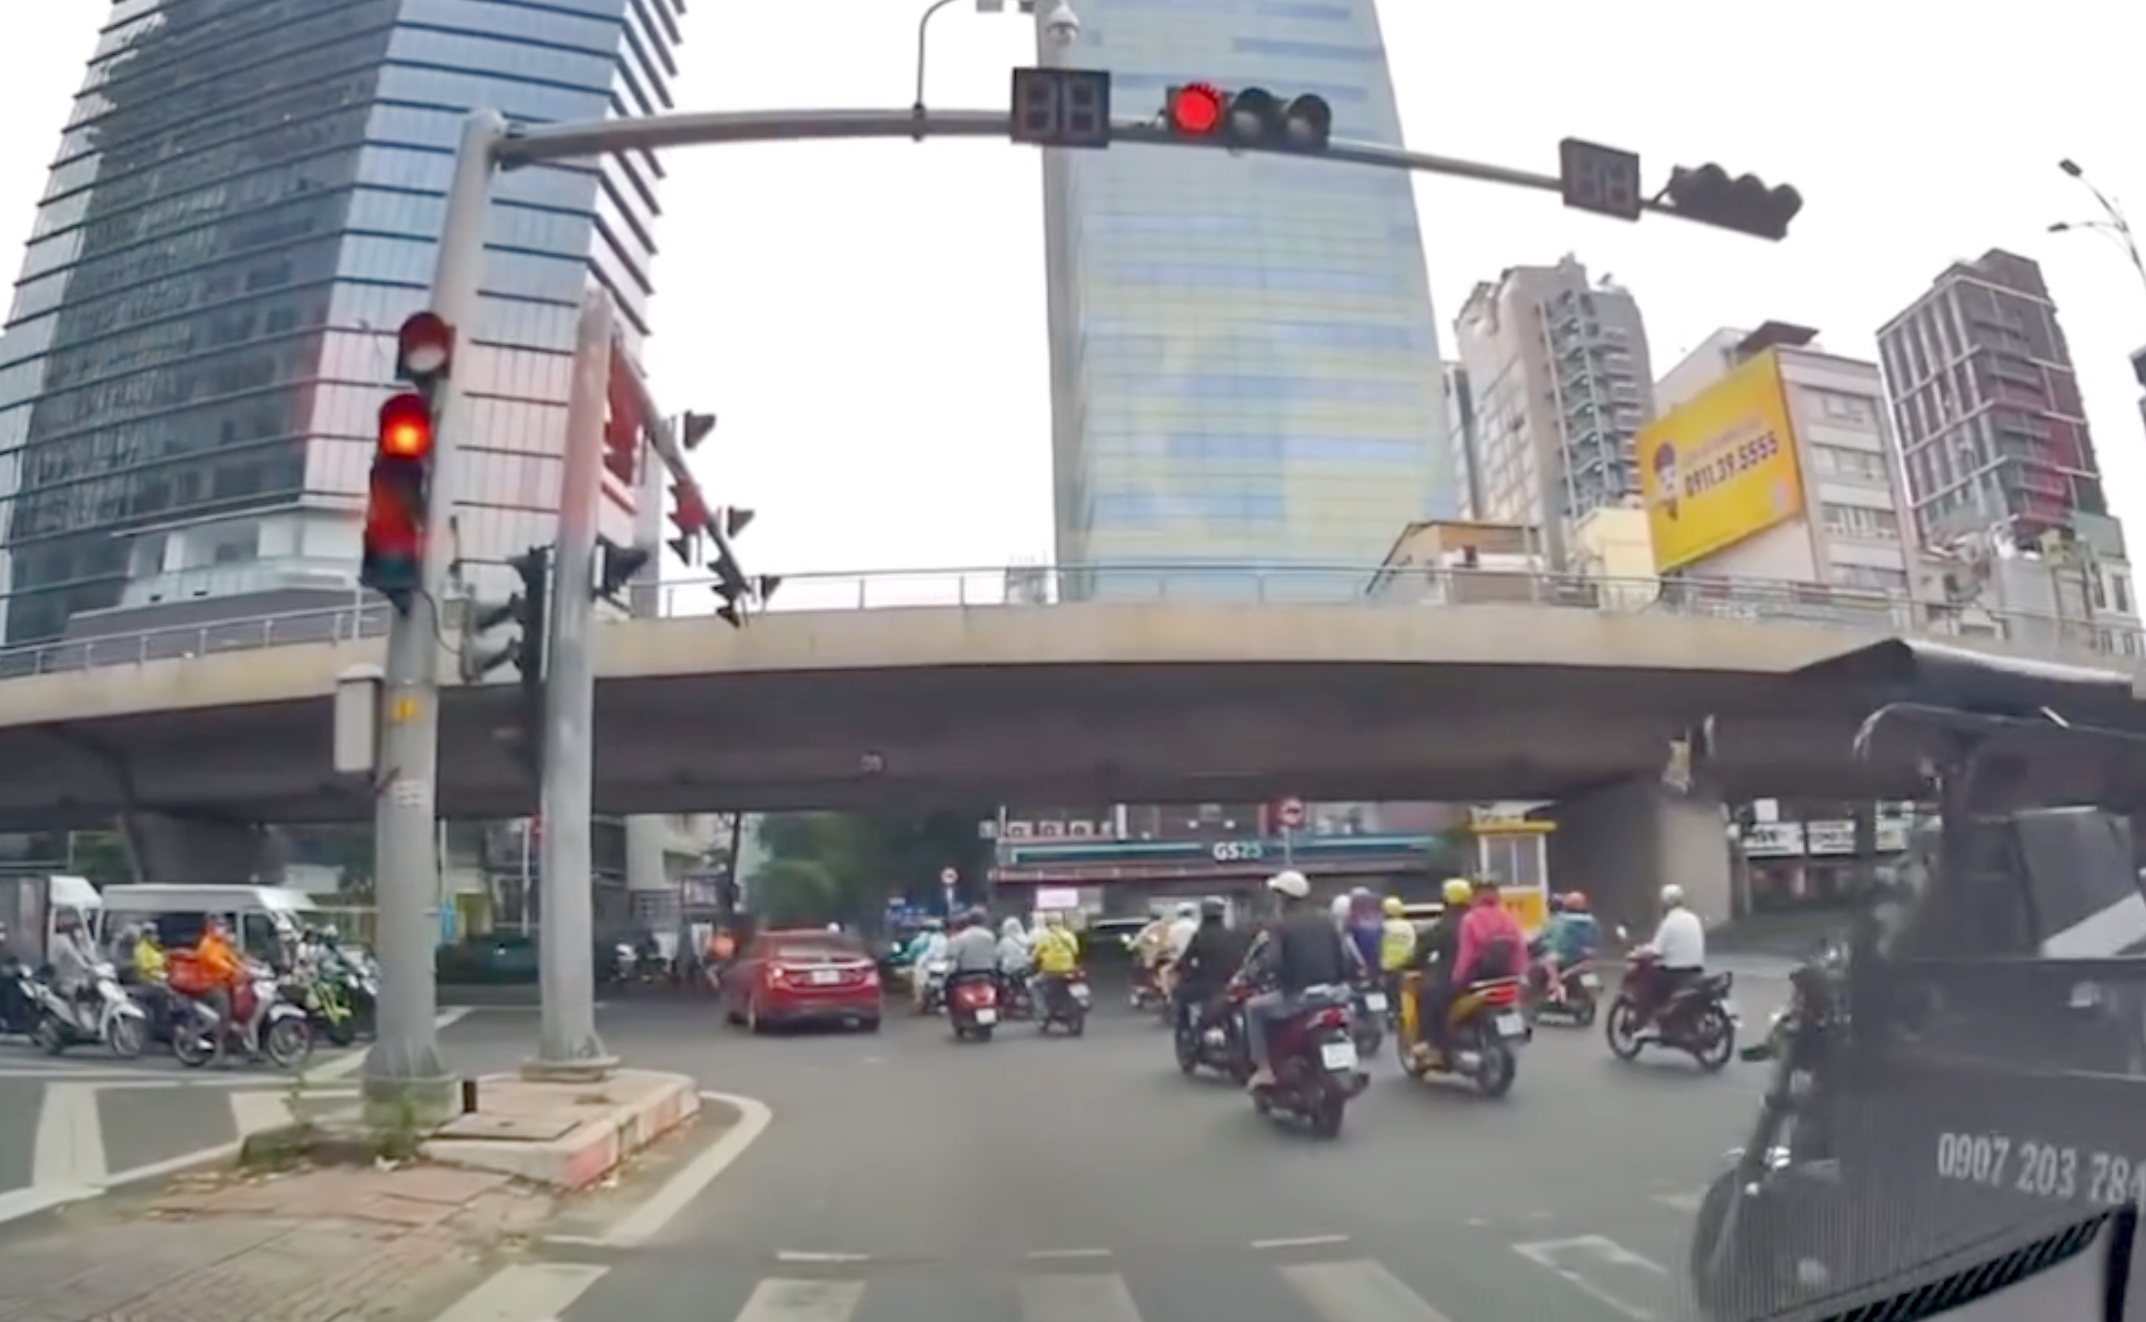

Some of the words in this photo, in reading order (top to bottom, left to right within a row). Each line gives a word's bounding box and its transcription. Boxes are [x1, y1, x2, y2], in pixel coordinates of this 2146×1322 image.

[1213, 841, 1263, 860] GS25
[1938, 1132, 2010, 1187] 0907
[2015, 1142, 2076, 1198] 203
